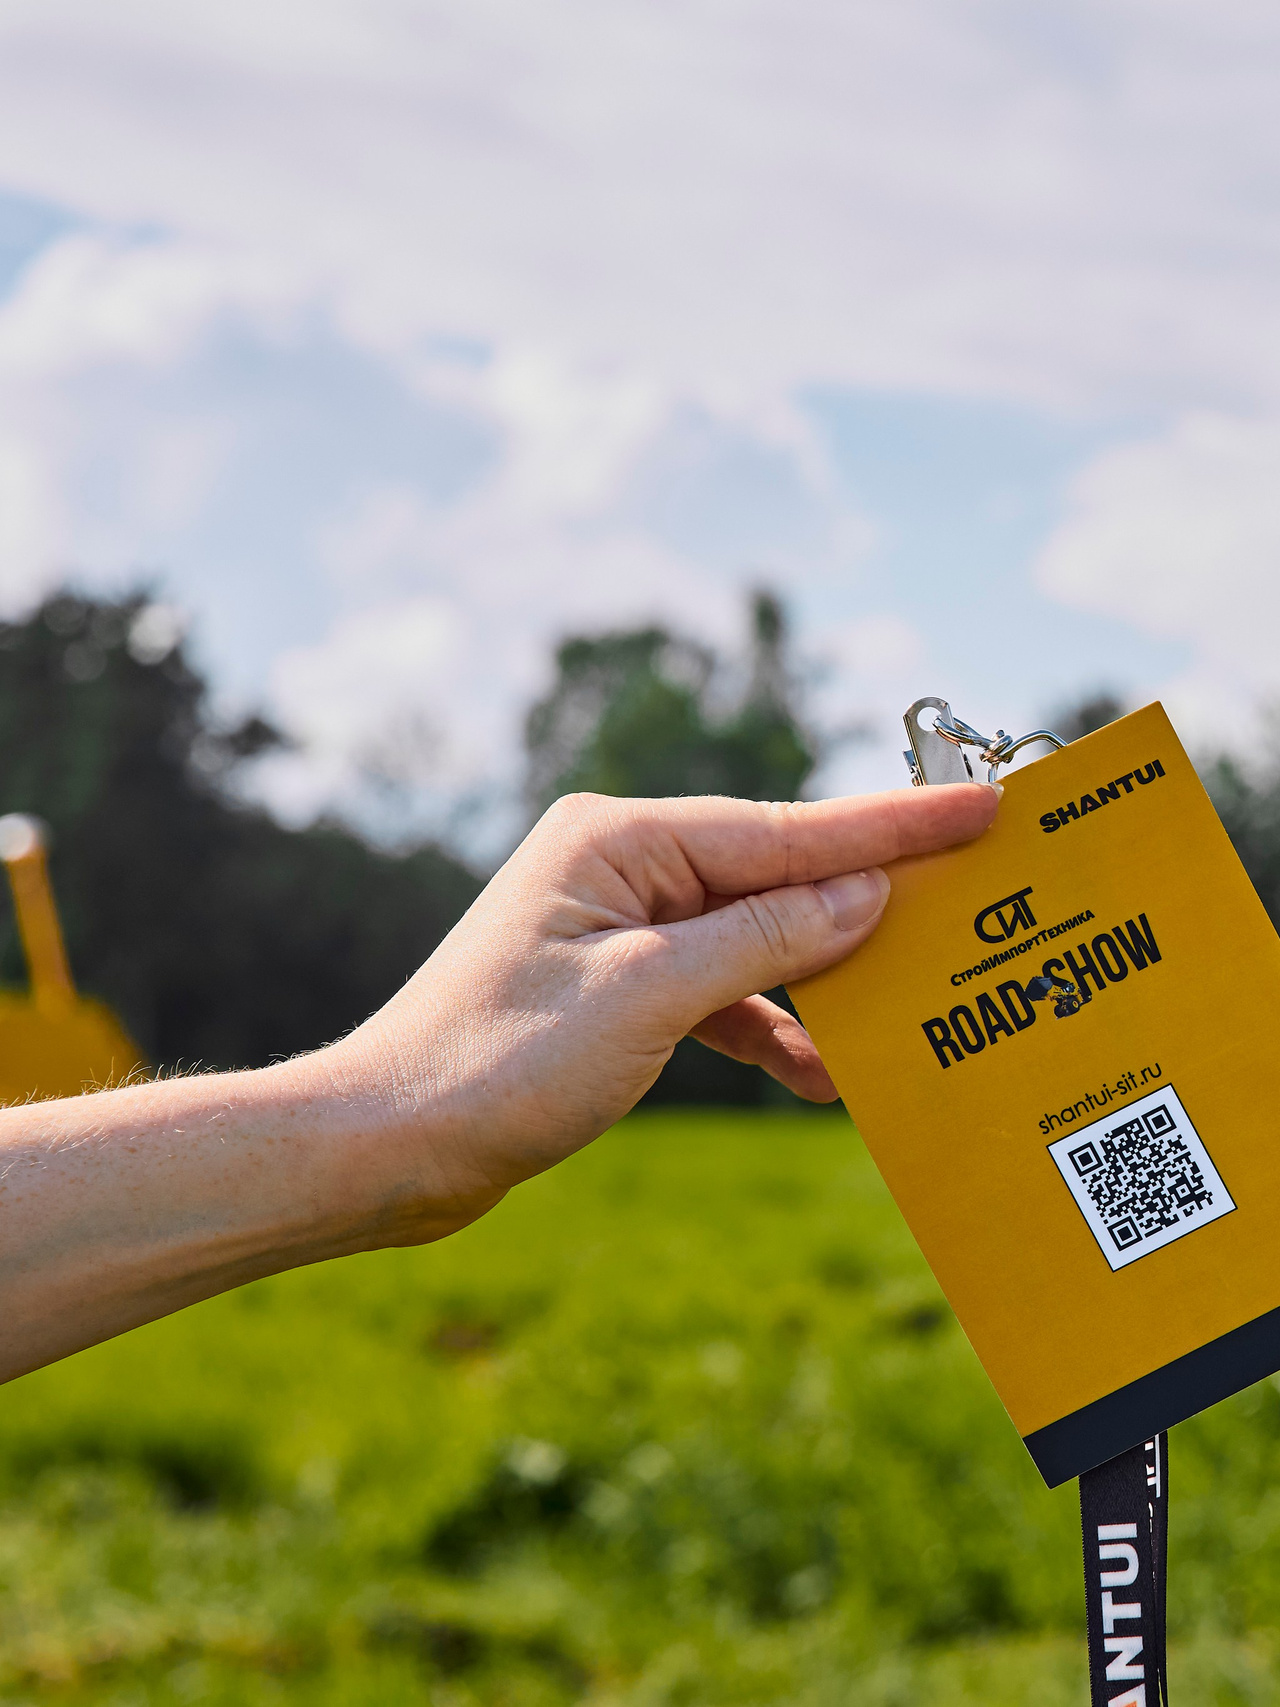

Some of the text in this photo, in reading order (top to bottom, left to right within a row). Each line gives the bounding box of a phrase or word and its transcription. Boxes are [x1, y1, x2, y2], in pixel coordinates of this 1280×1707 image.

[1039, 760, 1166, 833] SHANTUI
[973, 886, 1038, 944] СИТ
[921, 912, 1162, 1069] ROAD SHOW
[1038, 1063, 1162, 1135] shantui-sit.ru
